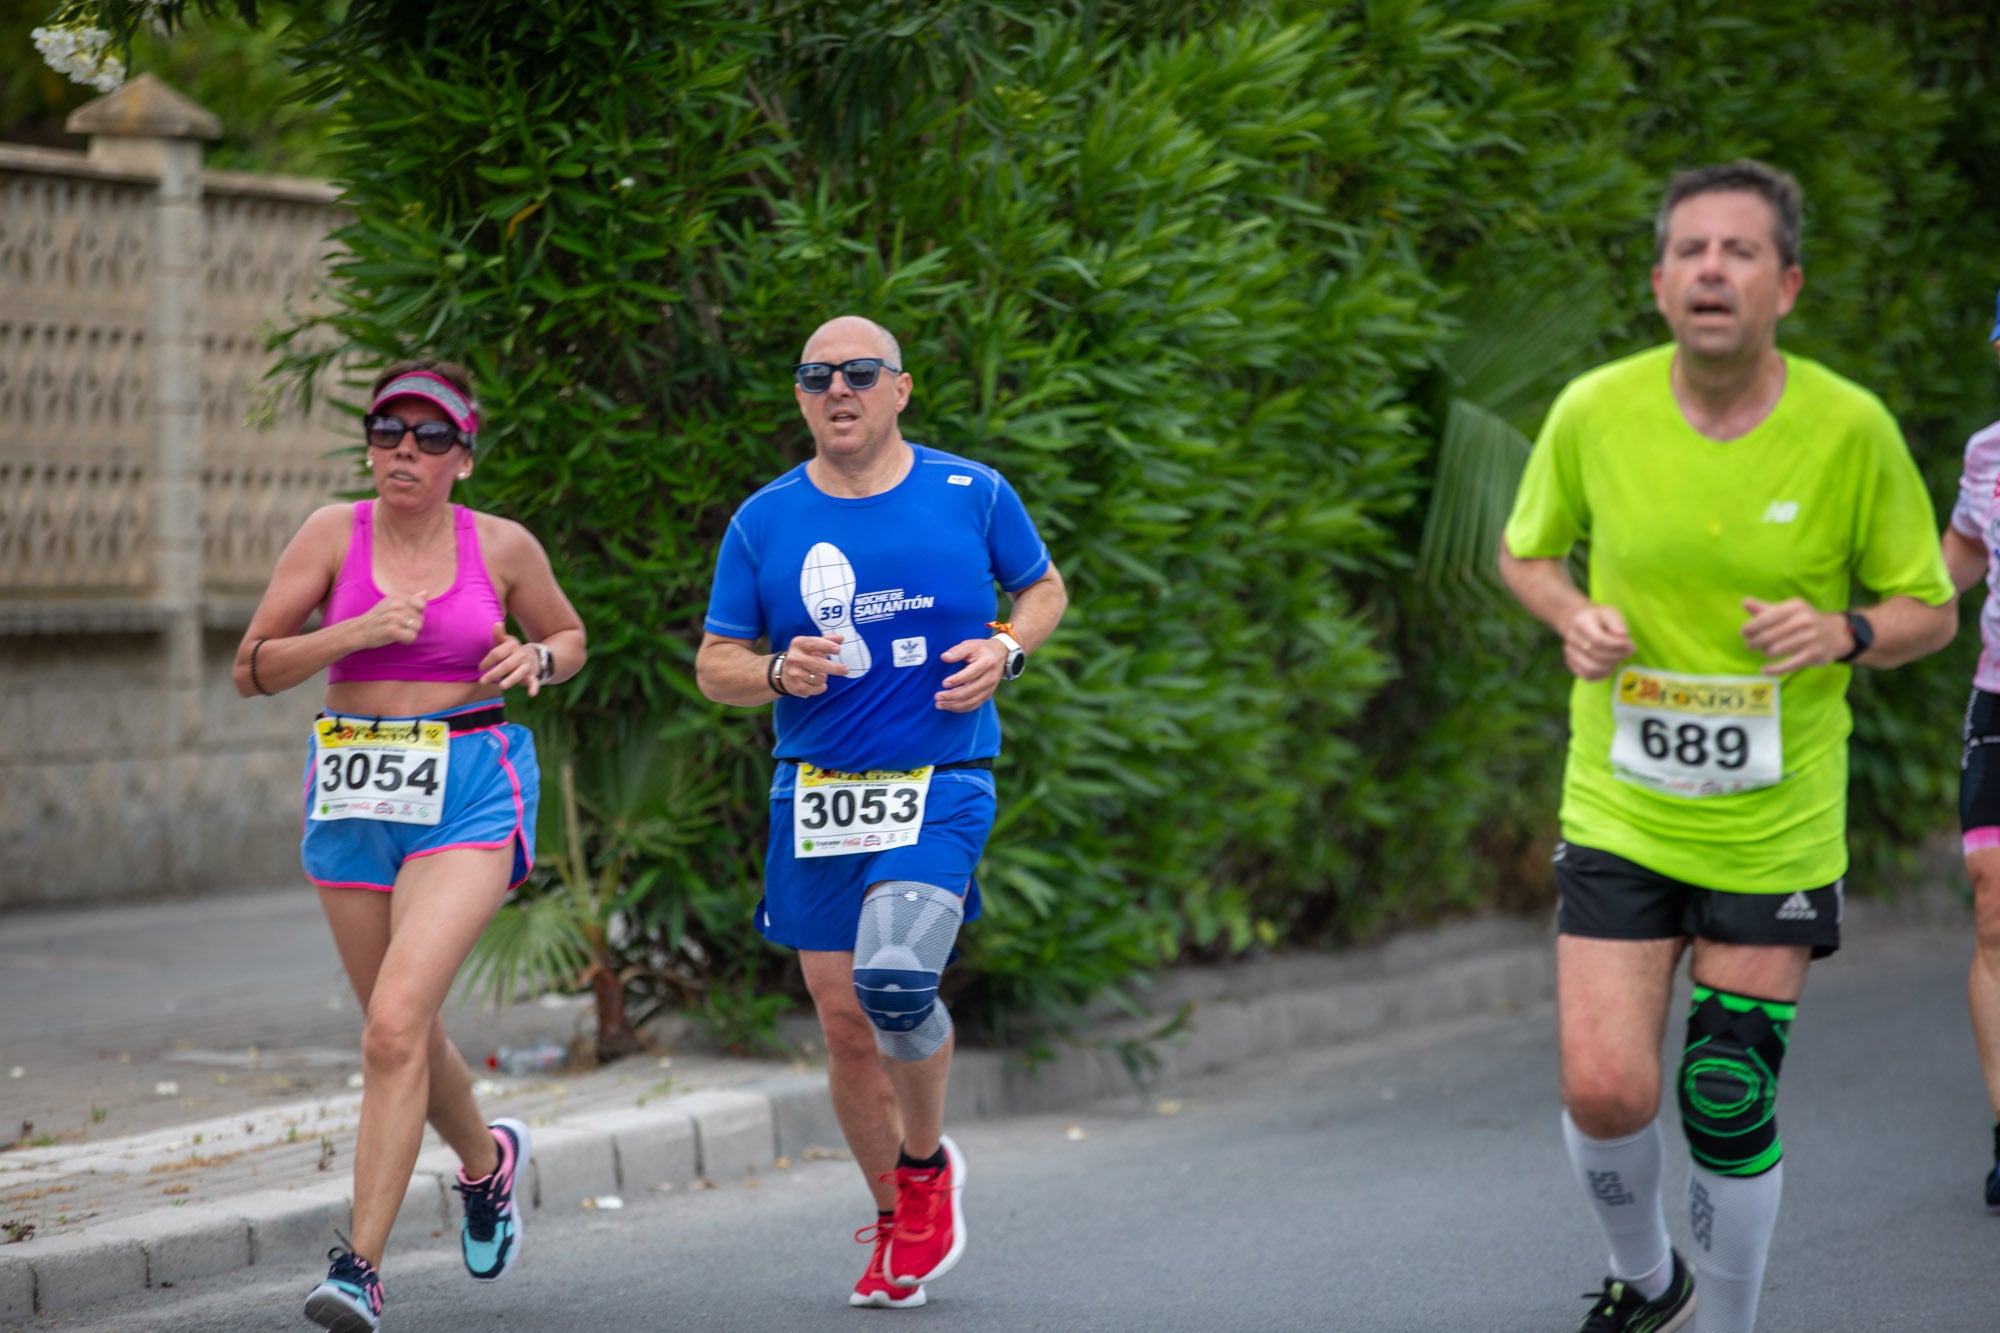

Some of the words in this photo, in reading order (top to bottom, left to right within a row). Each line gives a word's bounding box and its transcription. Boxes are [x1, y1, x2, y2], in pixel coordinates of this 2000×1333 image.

[819, 604, 843, 621] 39
[855, 594, 889, 606] NOCHE
[889, 591, 905, 601] DE
[1640, 717, 1749, 769] 689
[321, 753, 440, 797] 3054
[801, 788, 920, 830] 3053
